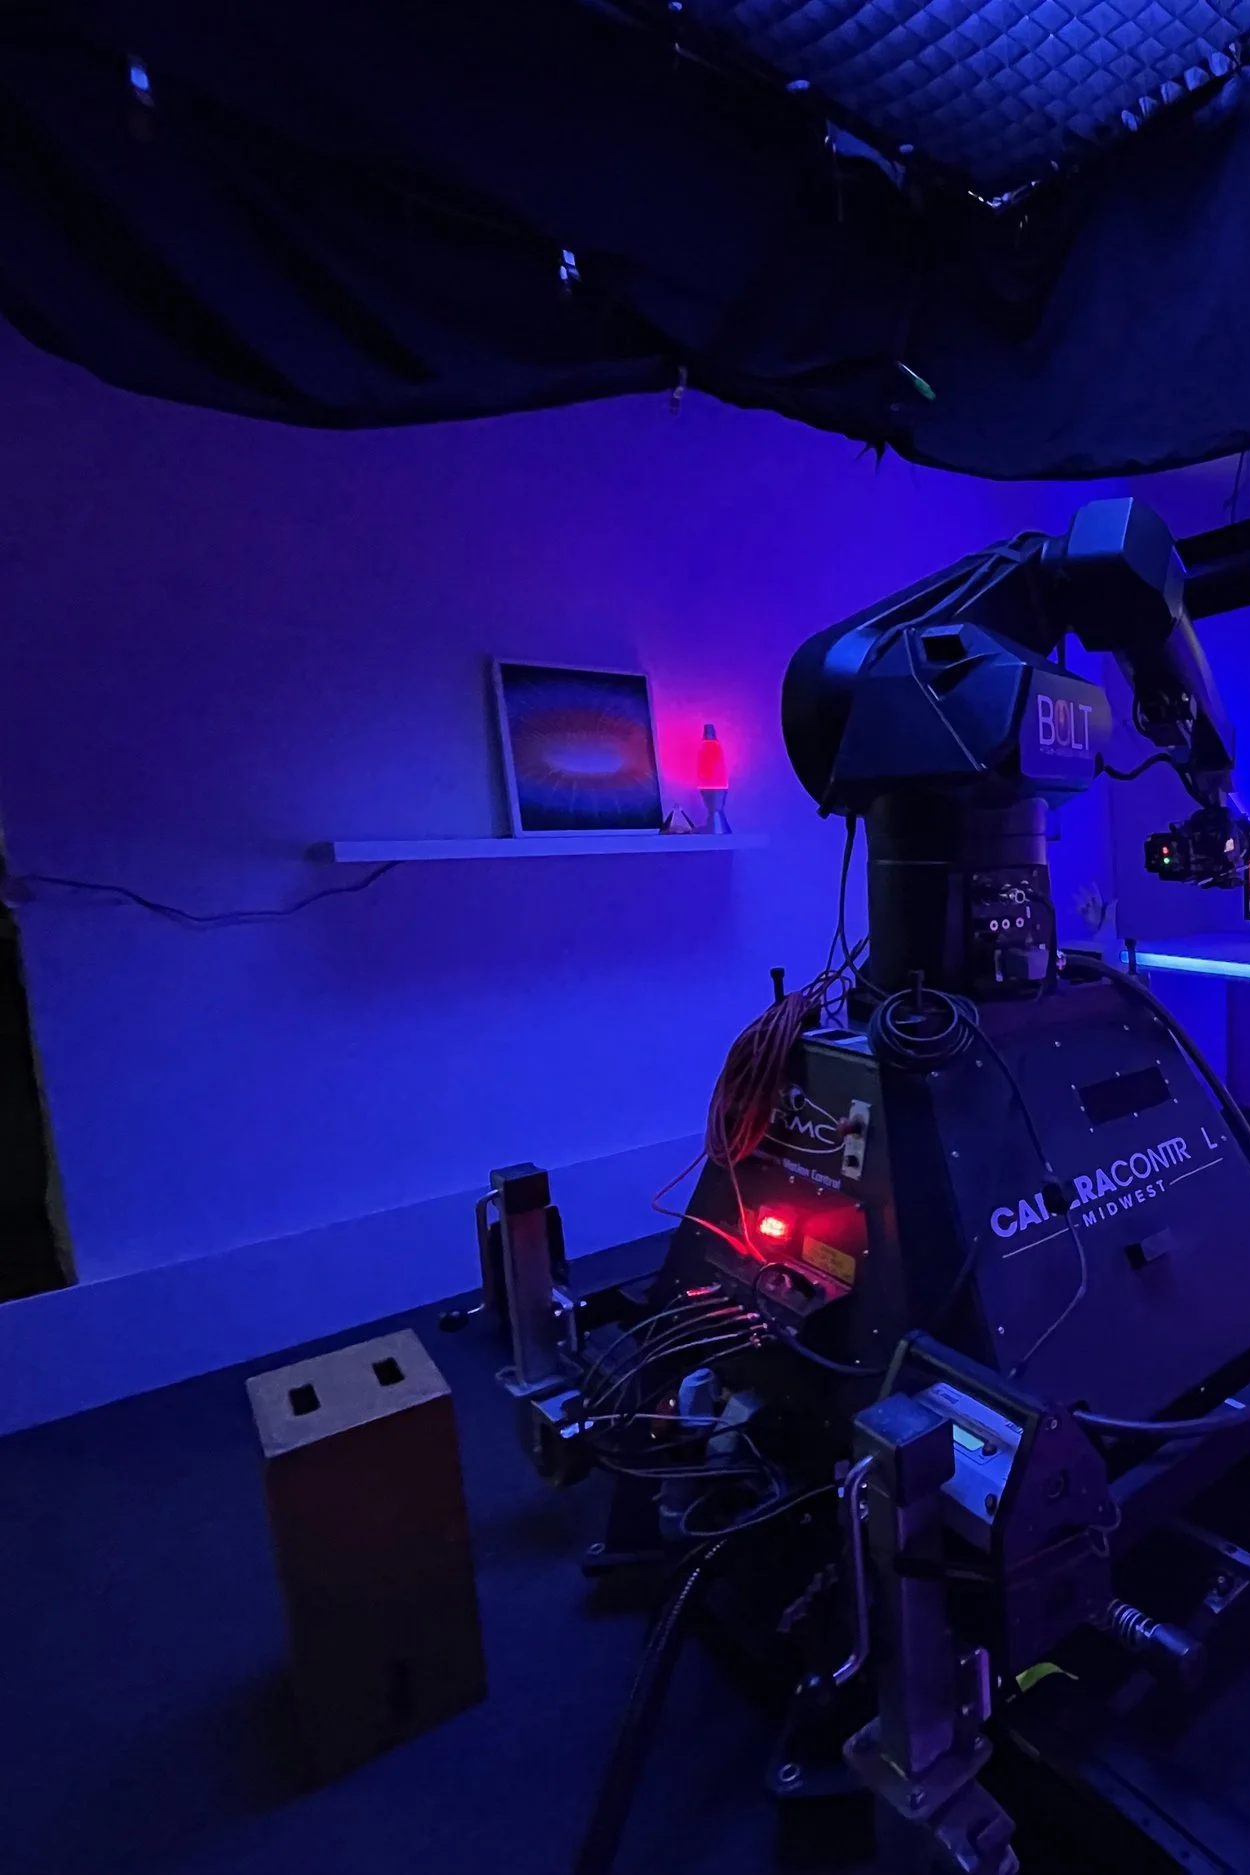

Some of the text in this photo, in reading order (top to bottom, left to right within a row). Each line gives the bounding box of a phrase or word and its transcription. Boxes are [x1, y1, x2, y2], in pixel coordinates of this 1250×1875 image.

[1037, 694, 1093, 751] BOLT
[811, 1170, 842, 1191] Control
[990, 1127, 1218, 1238] CARACONTRL
[1082, 1179, 1167, 1228] MIDWEST
